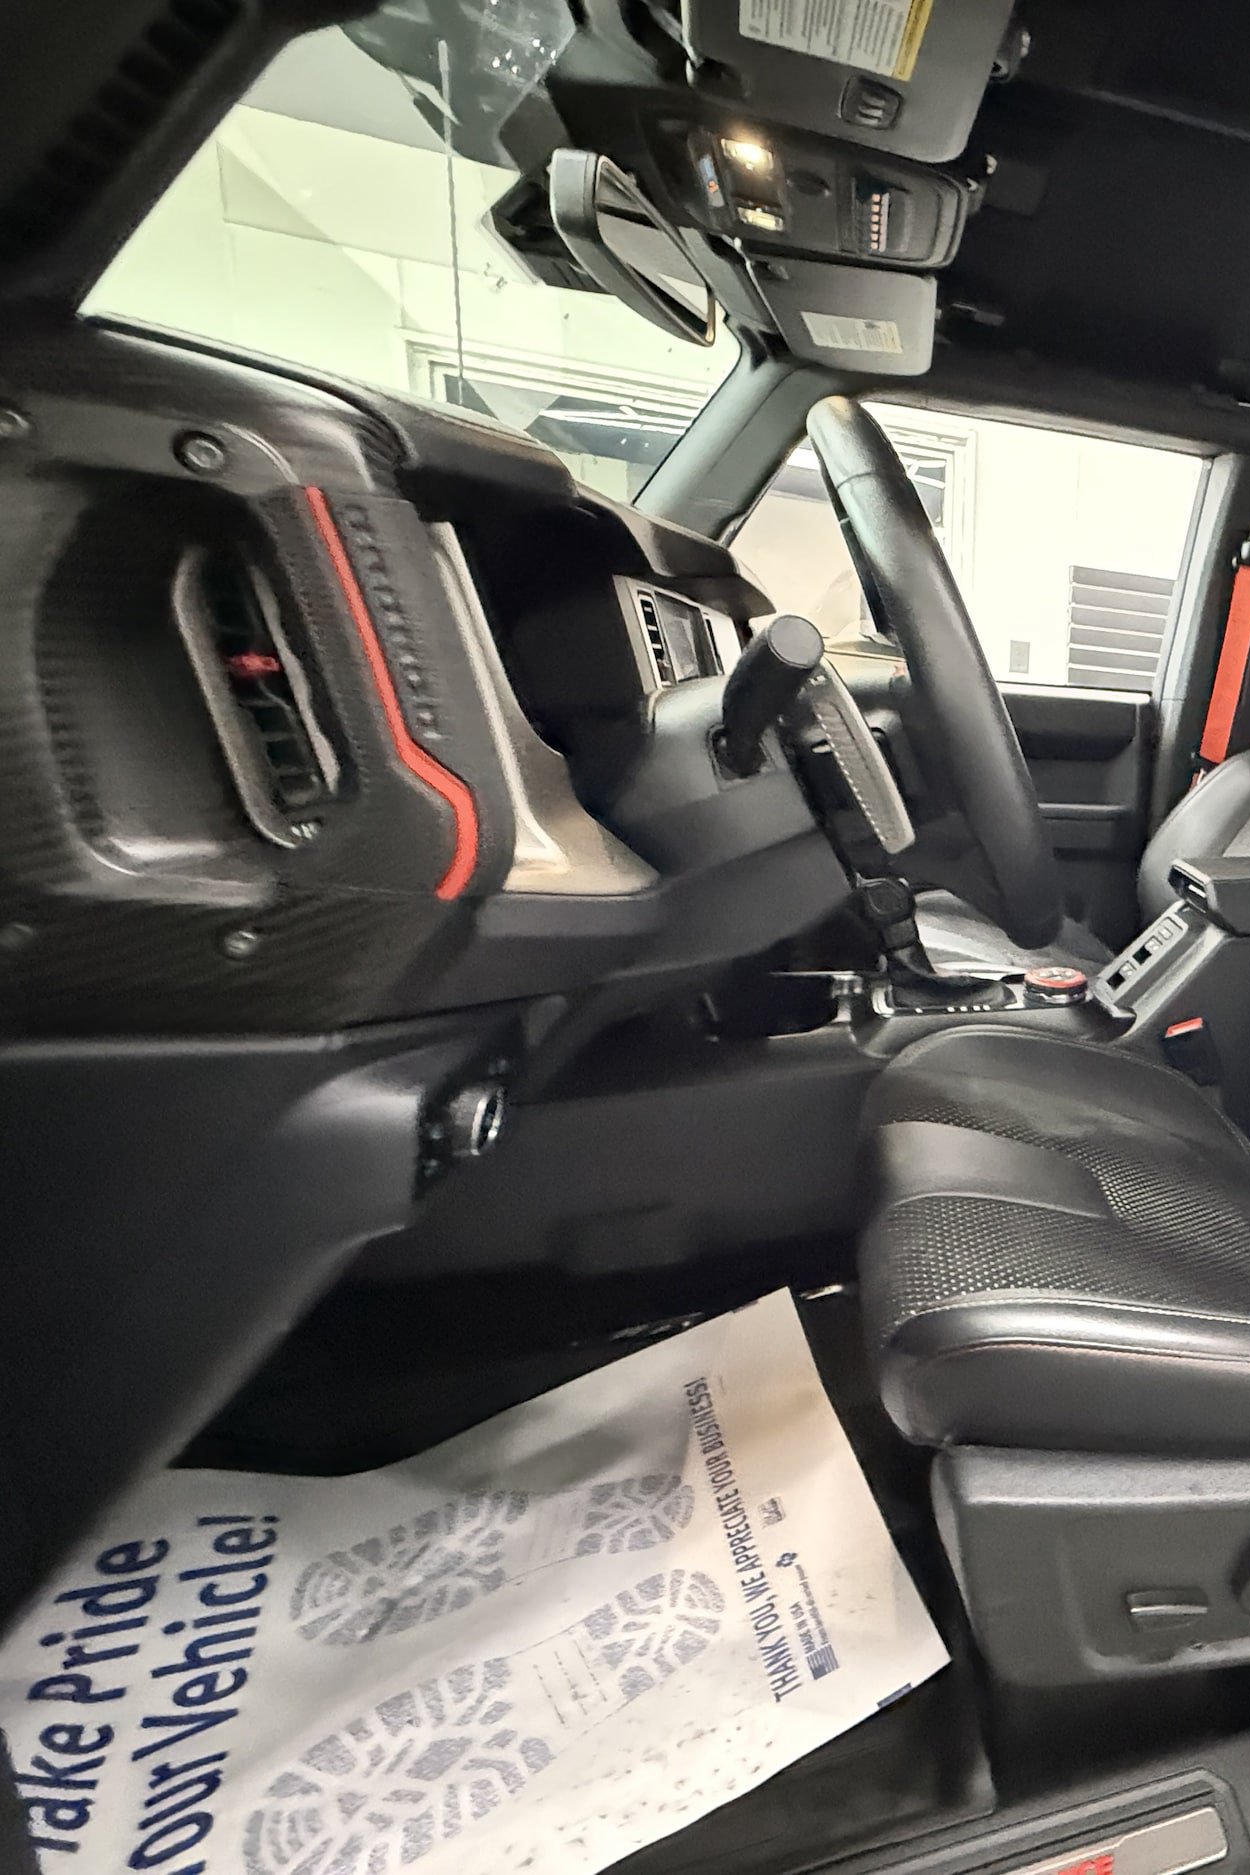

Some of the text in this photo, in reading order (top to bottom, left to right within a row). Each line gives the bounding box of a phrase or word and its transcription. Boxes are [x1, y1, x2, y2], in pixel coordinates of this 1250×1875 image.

[27, 1538, 170, 1703] Pride
[131, 1515, 280, 1761] Vehicle!
[684, 1376, 803, 1703] THANK YOU, WE APPRECIATE YOUR BUSINESS!
